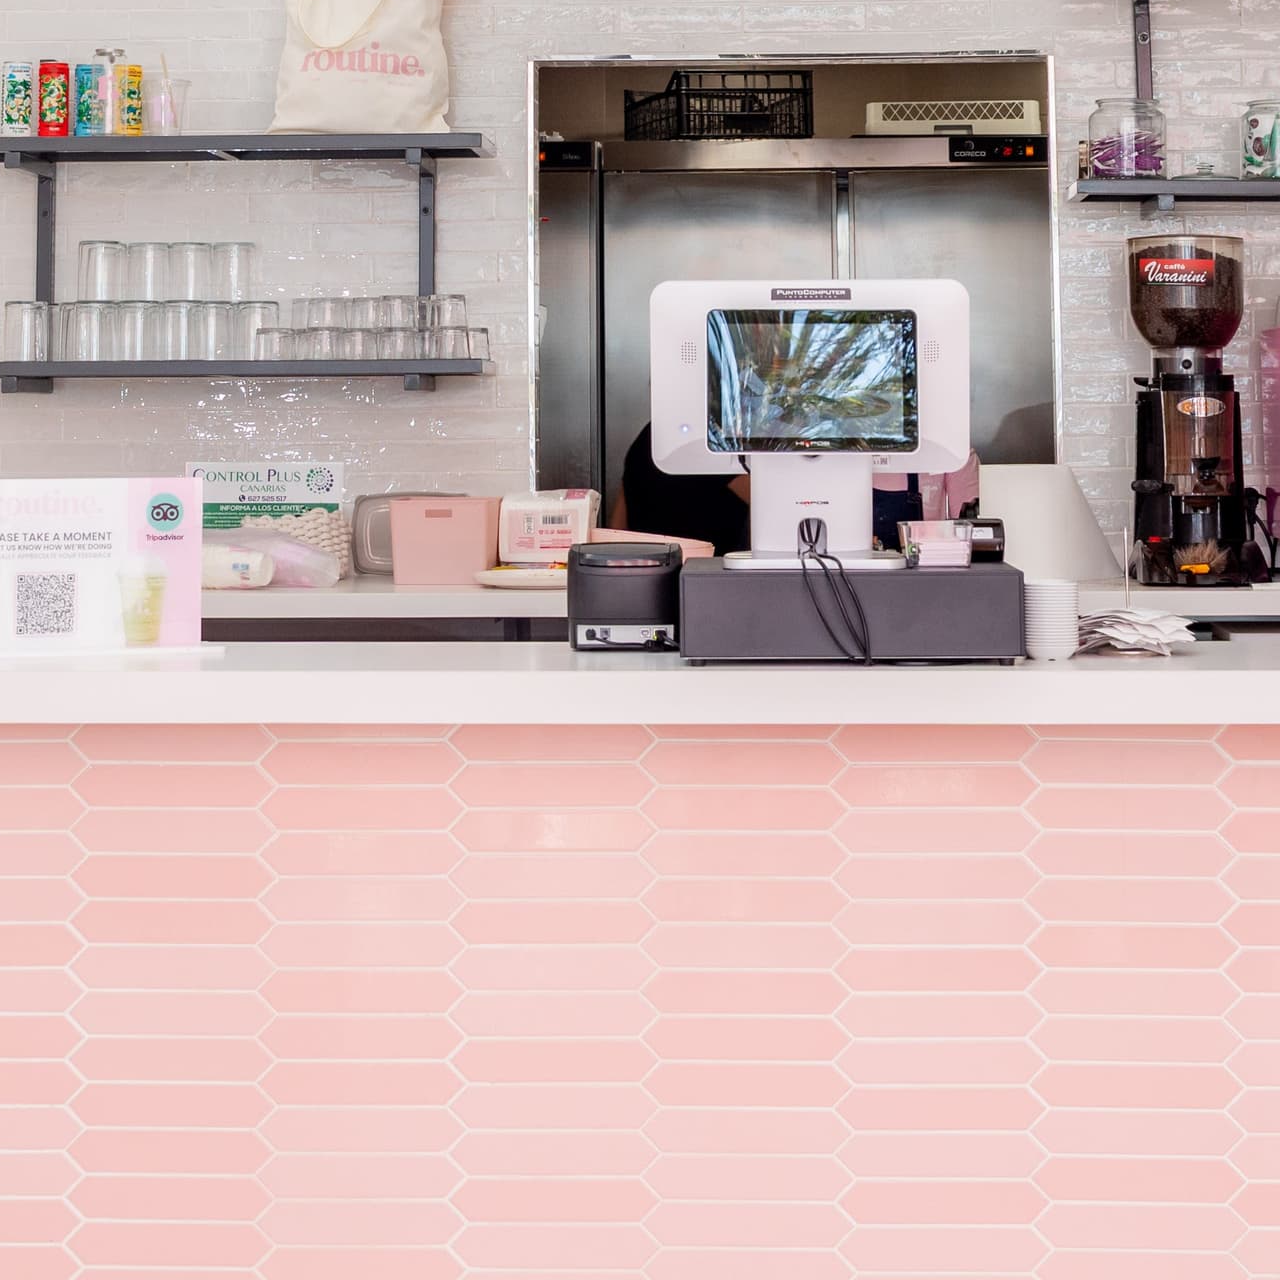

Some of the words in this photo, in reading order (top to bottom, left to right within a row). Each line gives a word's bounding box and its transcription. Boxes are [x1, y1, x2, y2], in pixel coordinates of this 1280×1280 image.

[299, 41, 425, 77] routine.
[1144, 261, 1207, 283] Varanini
[268, 469, 302, 483] PLUS
[240, 485, 287, 493] CANARIAS
[22, 532, 50, 542] TAKE
[53, 532, 61, 541] A
[63, 531, 112, 541] MOMENT
